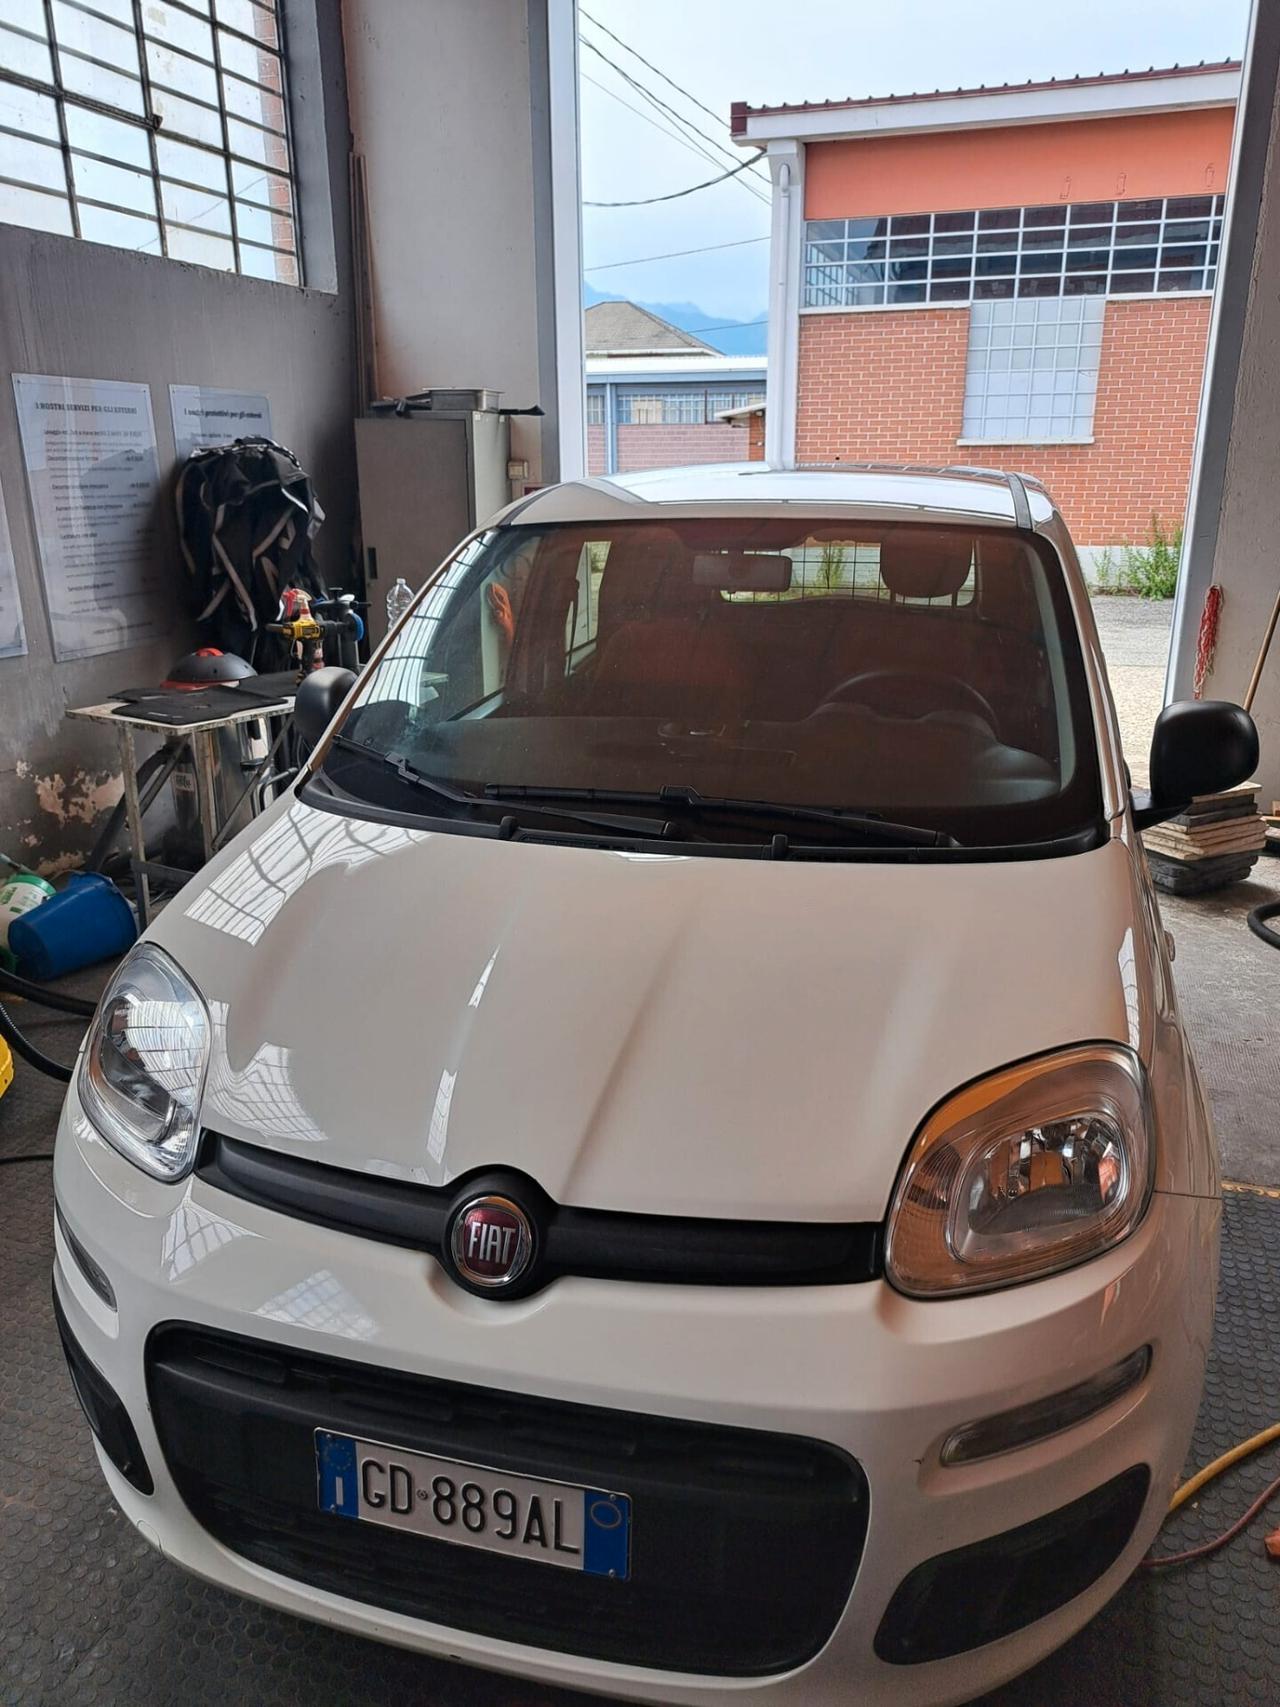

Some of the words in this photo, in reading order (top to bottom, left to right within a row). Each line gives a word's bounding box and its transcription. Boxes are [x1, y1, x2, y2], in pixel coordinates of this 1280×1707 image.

[468, 1221, 516, 1264] FIAT
[361, 1459, 413, 1515] GD
[431, 1475, 581, 1555] 889AL
